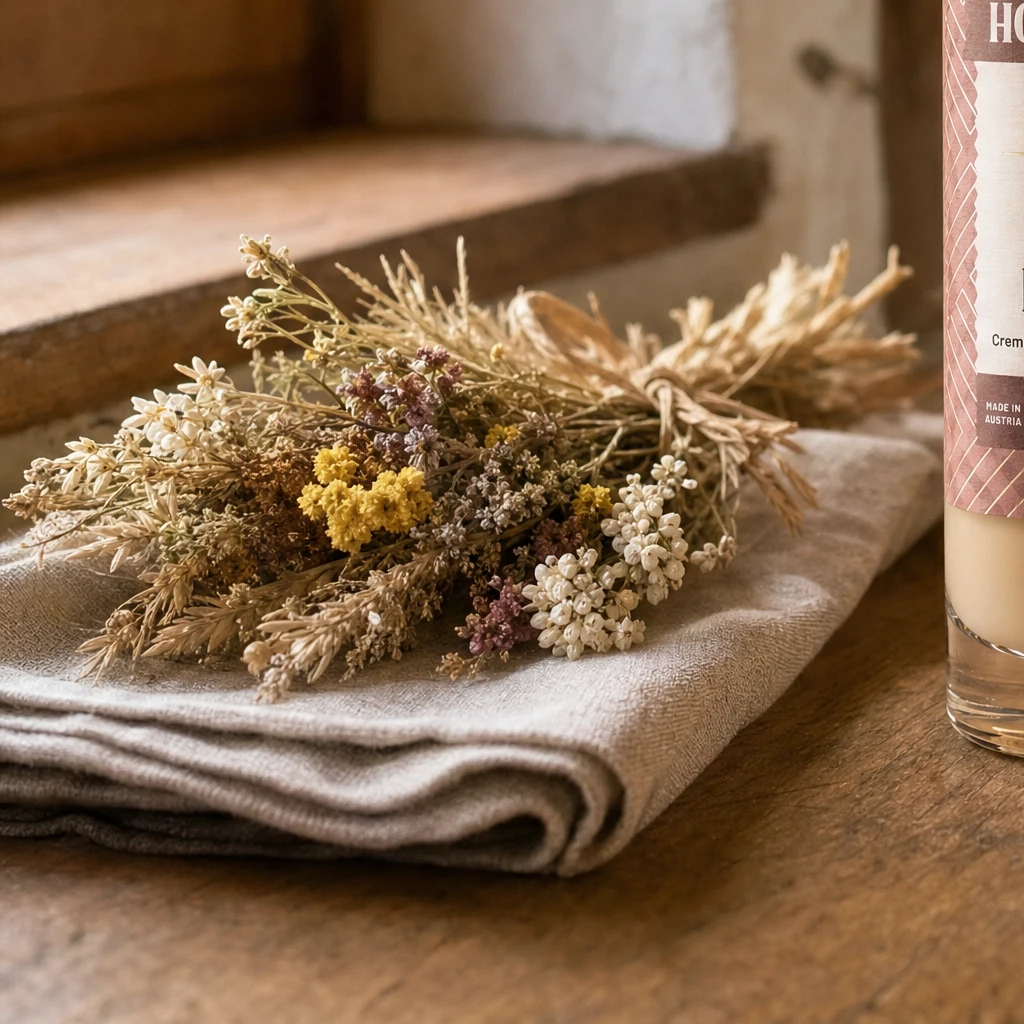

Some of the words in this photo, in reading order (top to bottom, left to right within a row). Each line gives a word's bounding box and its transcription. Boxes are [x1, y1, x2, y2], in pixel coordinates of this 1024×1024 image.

[986, 402, 1009, 413] MADE
[1011, 404, 1021, 413] IN
[984, 415, 1022, 426] AUSTRIA
